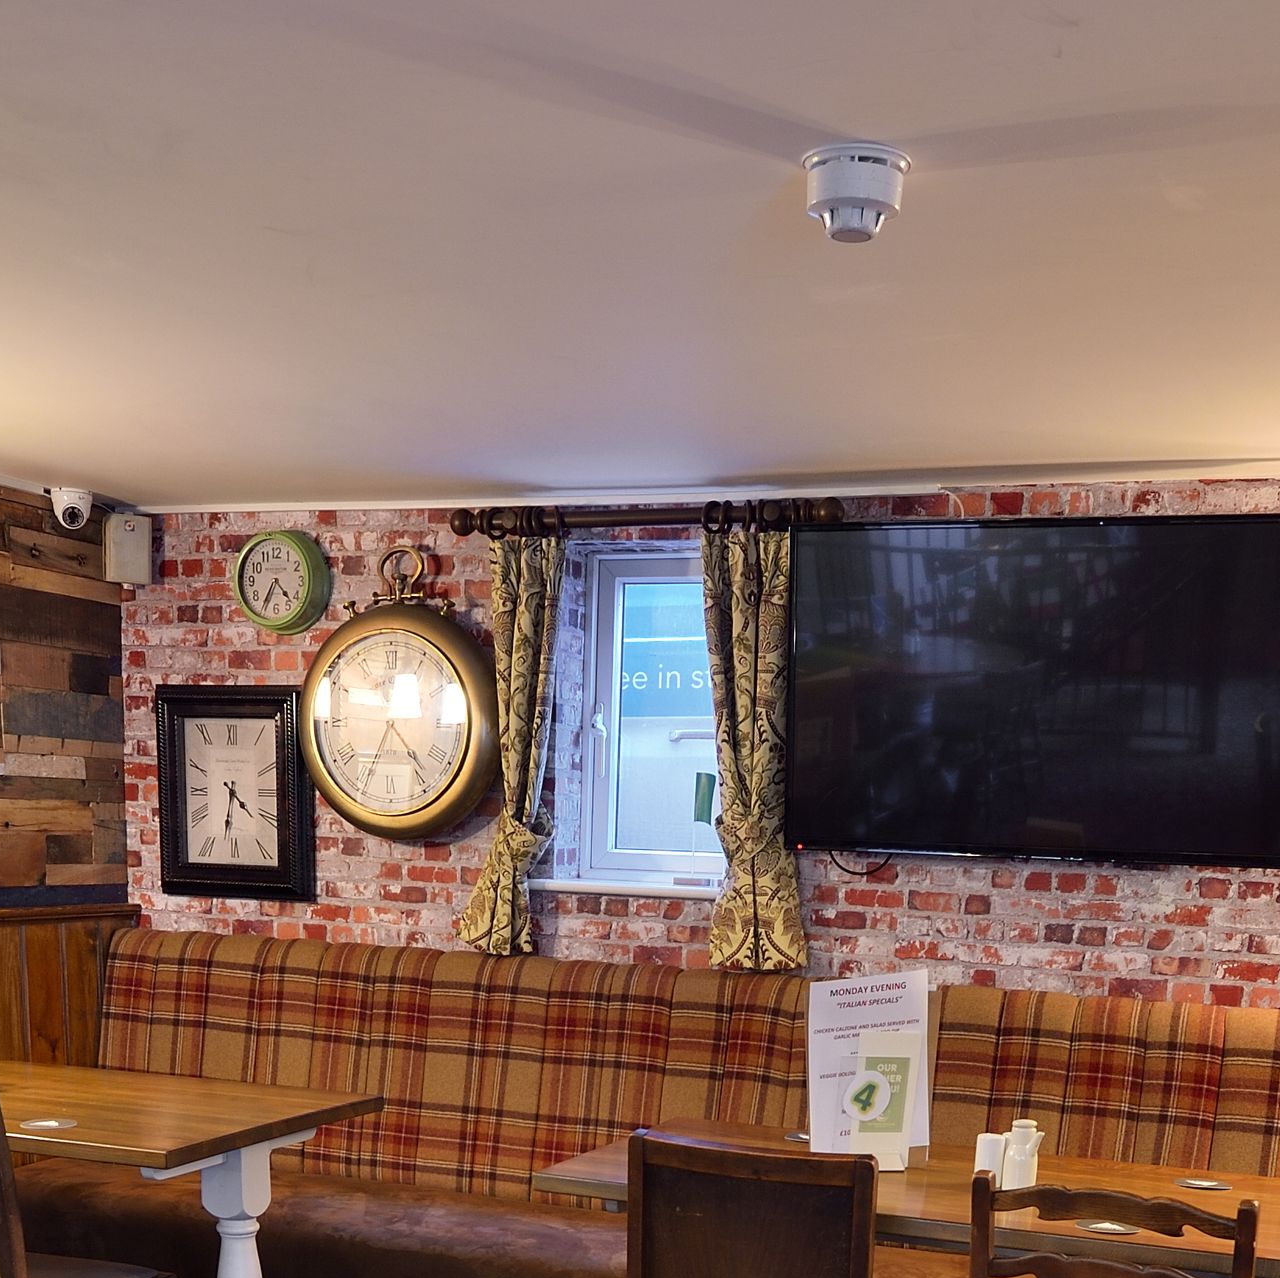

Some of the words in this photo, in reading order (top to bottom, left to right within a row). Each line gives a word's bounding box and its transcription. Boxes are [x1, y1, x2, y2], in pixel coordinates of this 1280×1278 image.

[262, 551, 269, 562] 11
[272, 547, 282, 559] 12
[286, 551, 290, 562] 1
[252, 562, 262, 574] 10
[294, 561, 300, 572] 2
[248, 575, 255, 587] 9
[298, 576, 304, 587] 3
[253, 590, 259, 601] 8
[293, 590, 299, 601] 4
[273, 603, 280, 615] 6
[285, 601, 292, 611] 5
[658, 664, 681, 689] in
[830, 986, 869, 997] MONDAY
[870, 981, 907, 993] EVENING
[835, 1025, 857, 1033] CALZONE
[877, 1064, 897, 1072] OUR
[853, 1084, 876, 1111] 4
